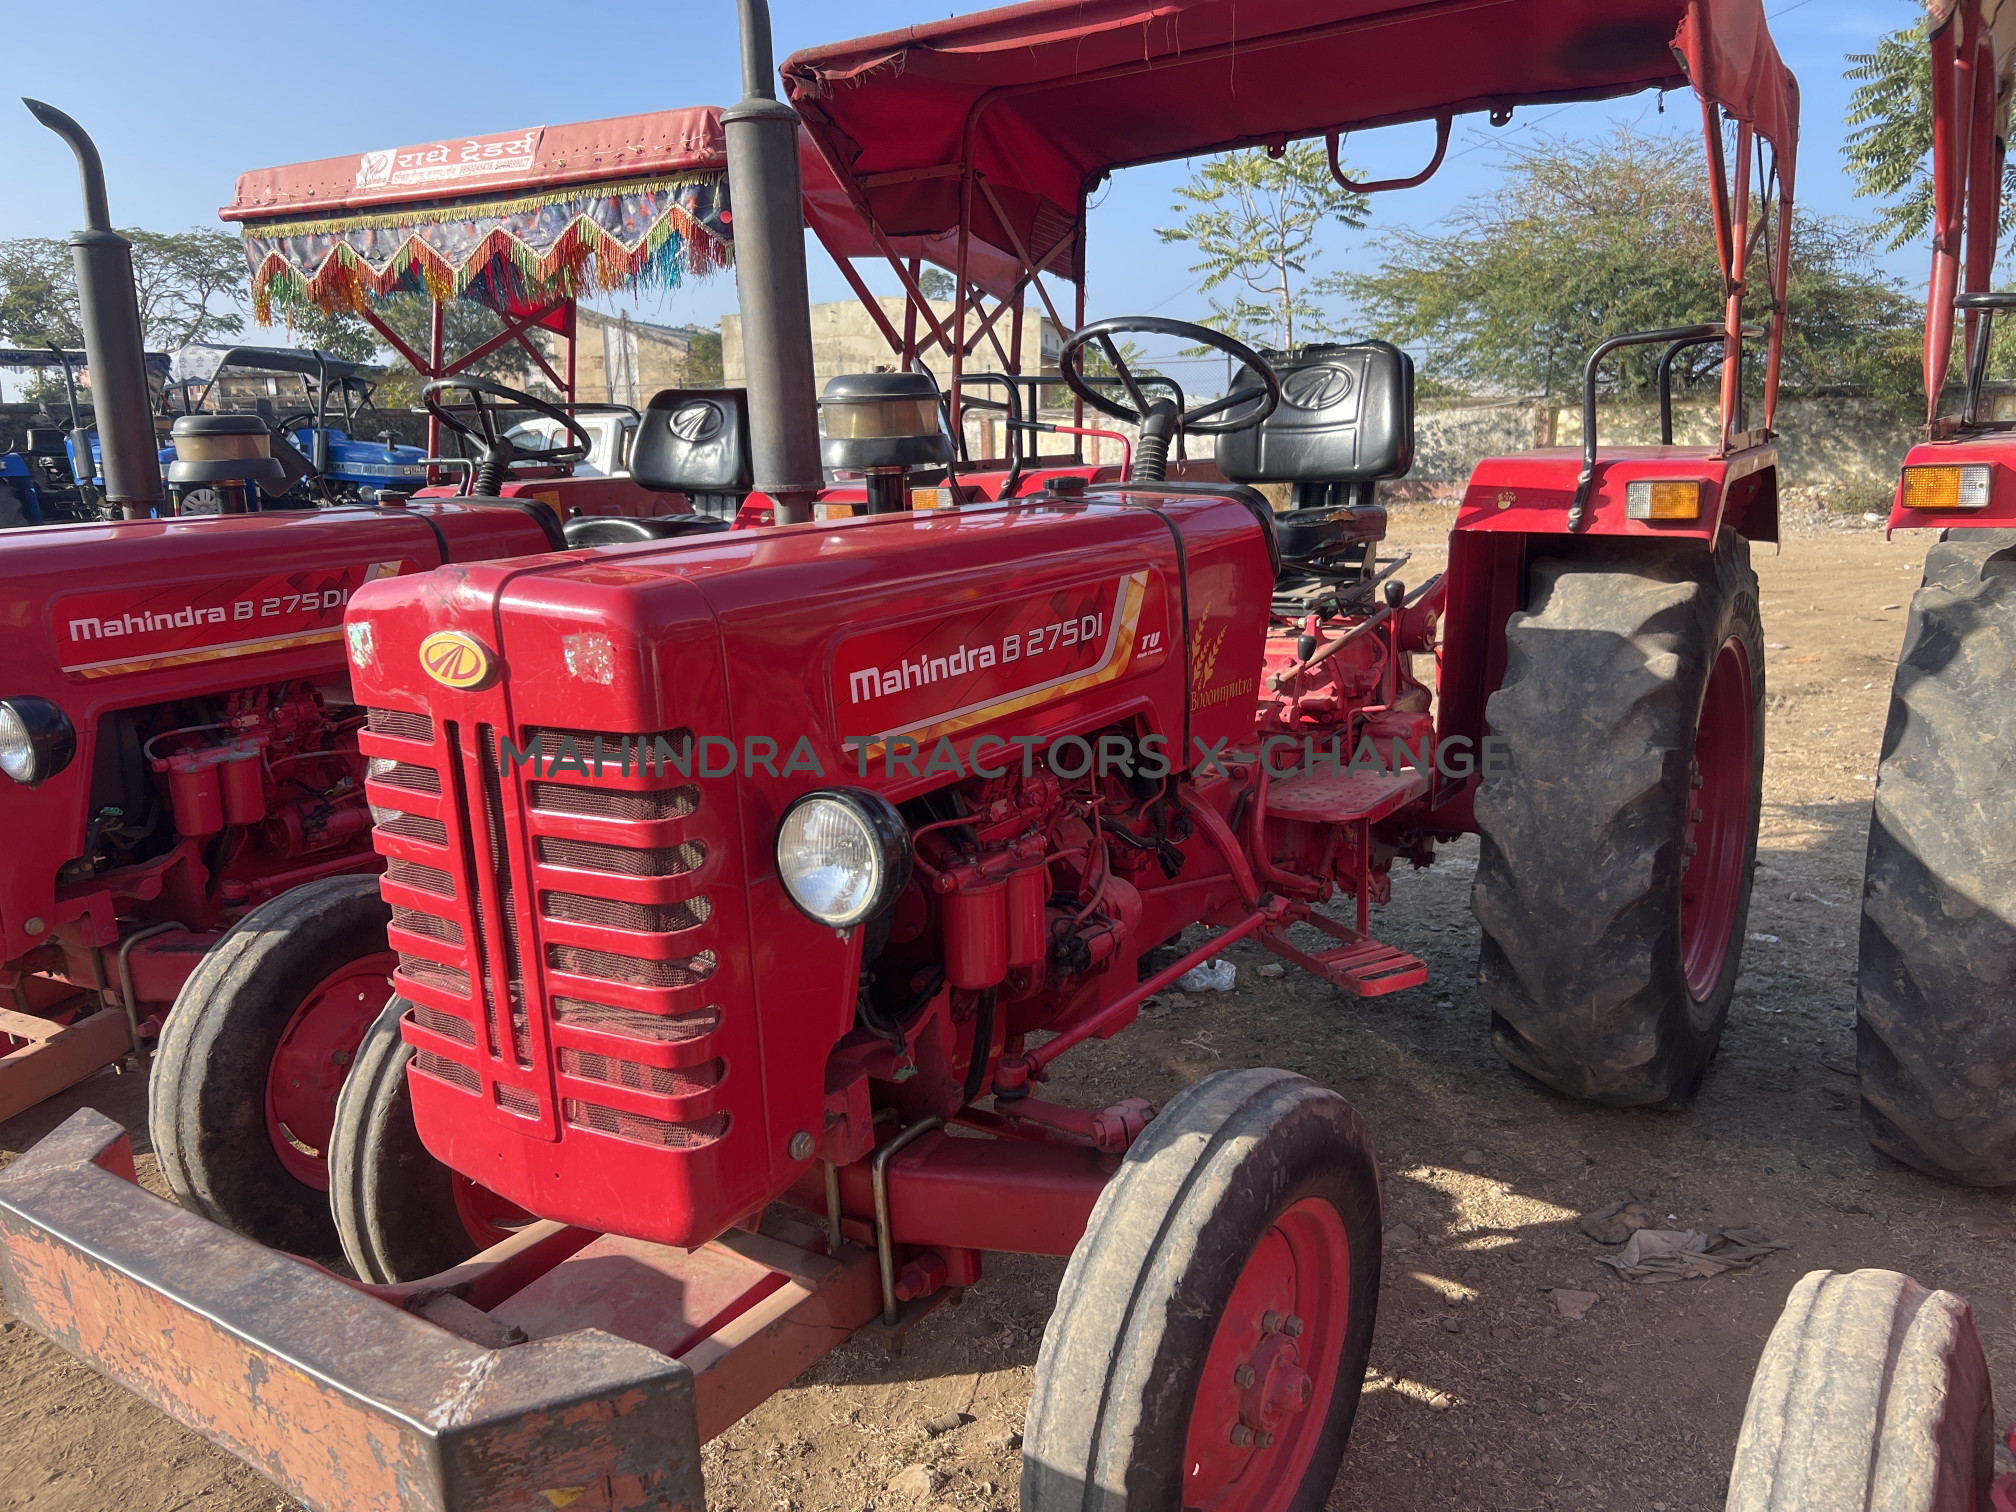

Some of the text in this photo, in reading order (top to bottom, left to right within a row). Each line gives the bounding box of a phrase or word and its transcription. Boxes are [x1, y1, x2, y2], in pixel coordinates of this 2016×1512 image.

[398, 132, 536, 168] राधे ट्रेडर्स
[69, 588, 348, 642] Mahindra B 275DI
[849, 612, 1103, 704] Mahindra B 275DI
[1141, 631, 1160, 650] TU
[1190, 677, 1253, 711] Bhoomiputra
